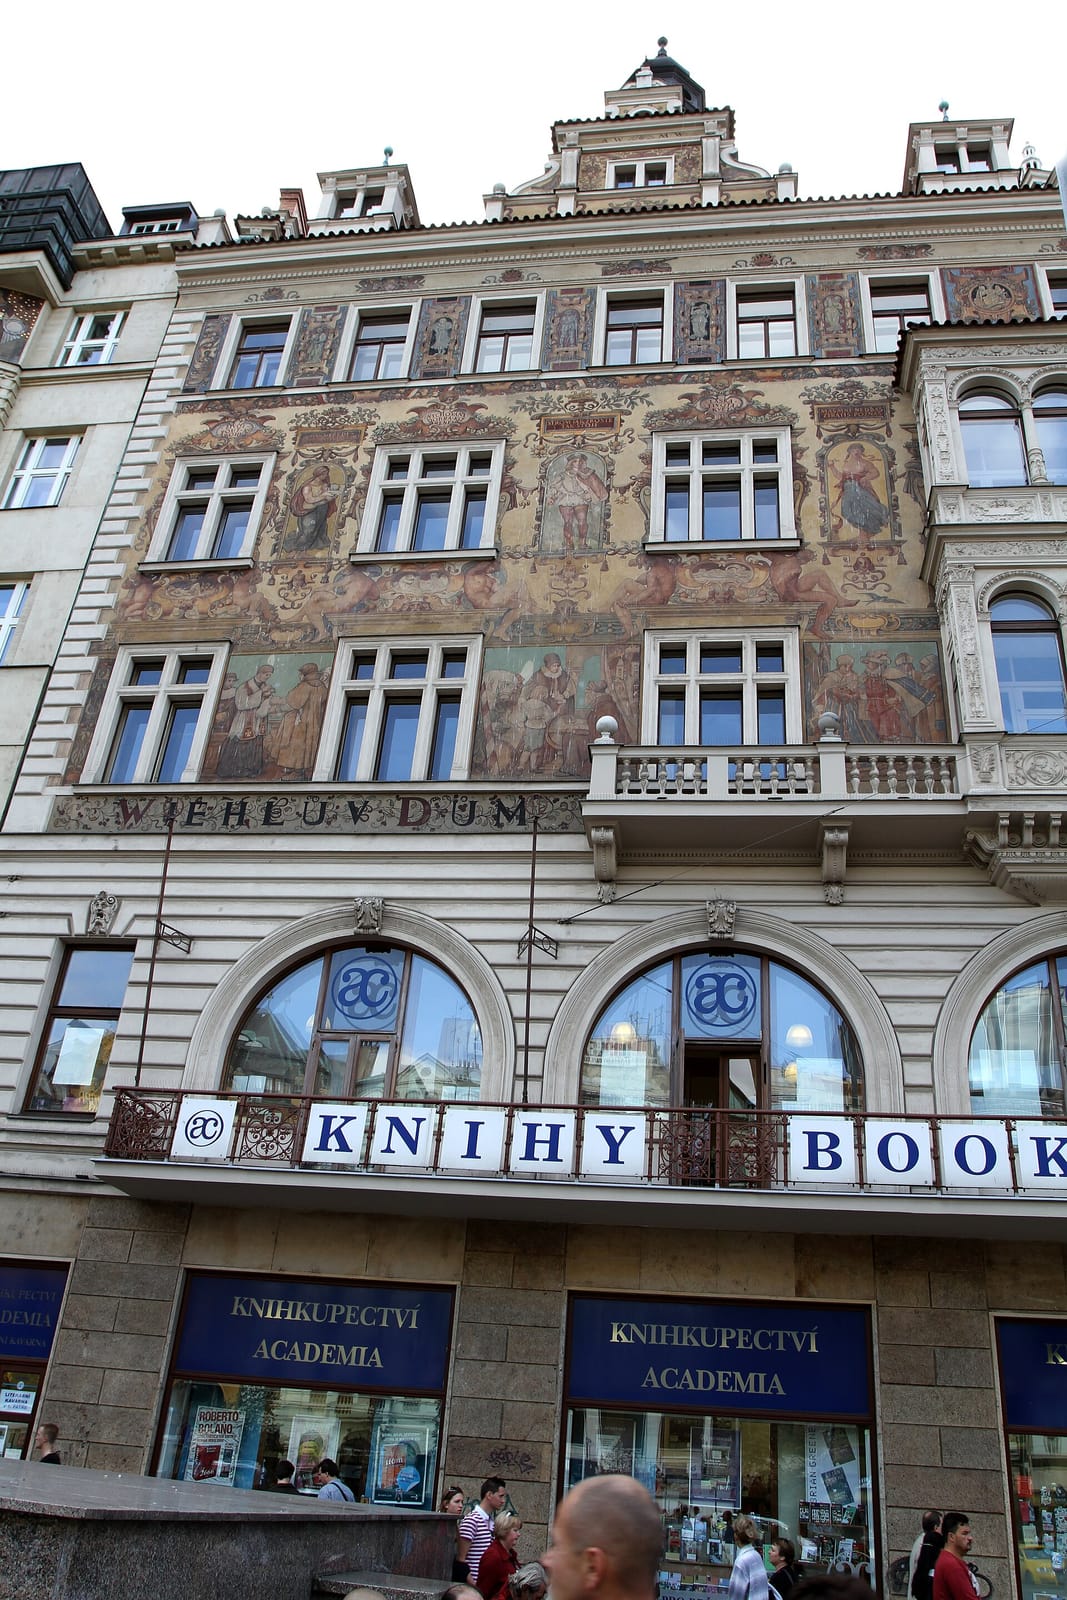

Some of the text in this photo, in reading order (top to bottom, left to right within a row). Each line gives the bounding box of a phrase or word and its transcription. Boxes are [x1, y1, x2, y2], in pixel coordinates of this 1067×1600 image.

[315, 1114, 635, 1164] KNIHY
[803, 1130, 1067, 1178] BOOK
[230, 1296, 420, 1329] KNIHKUPECTVÍ
[609, 1321, 819, 1353] KNIHKUPECTVÍ
[253, 1339, 384, 1368] ACADEMIA
[1045, 1343, 1067, 1365] K
[641, 1367, 786, 1395] ACADEMIA
[199, 1411, 239, 1422] ROBERTO
[808, 1425, 817, 1467] GREENE
